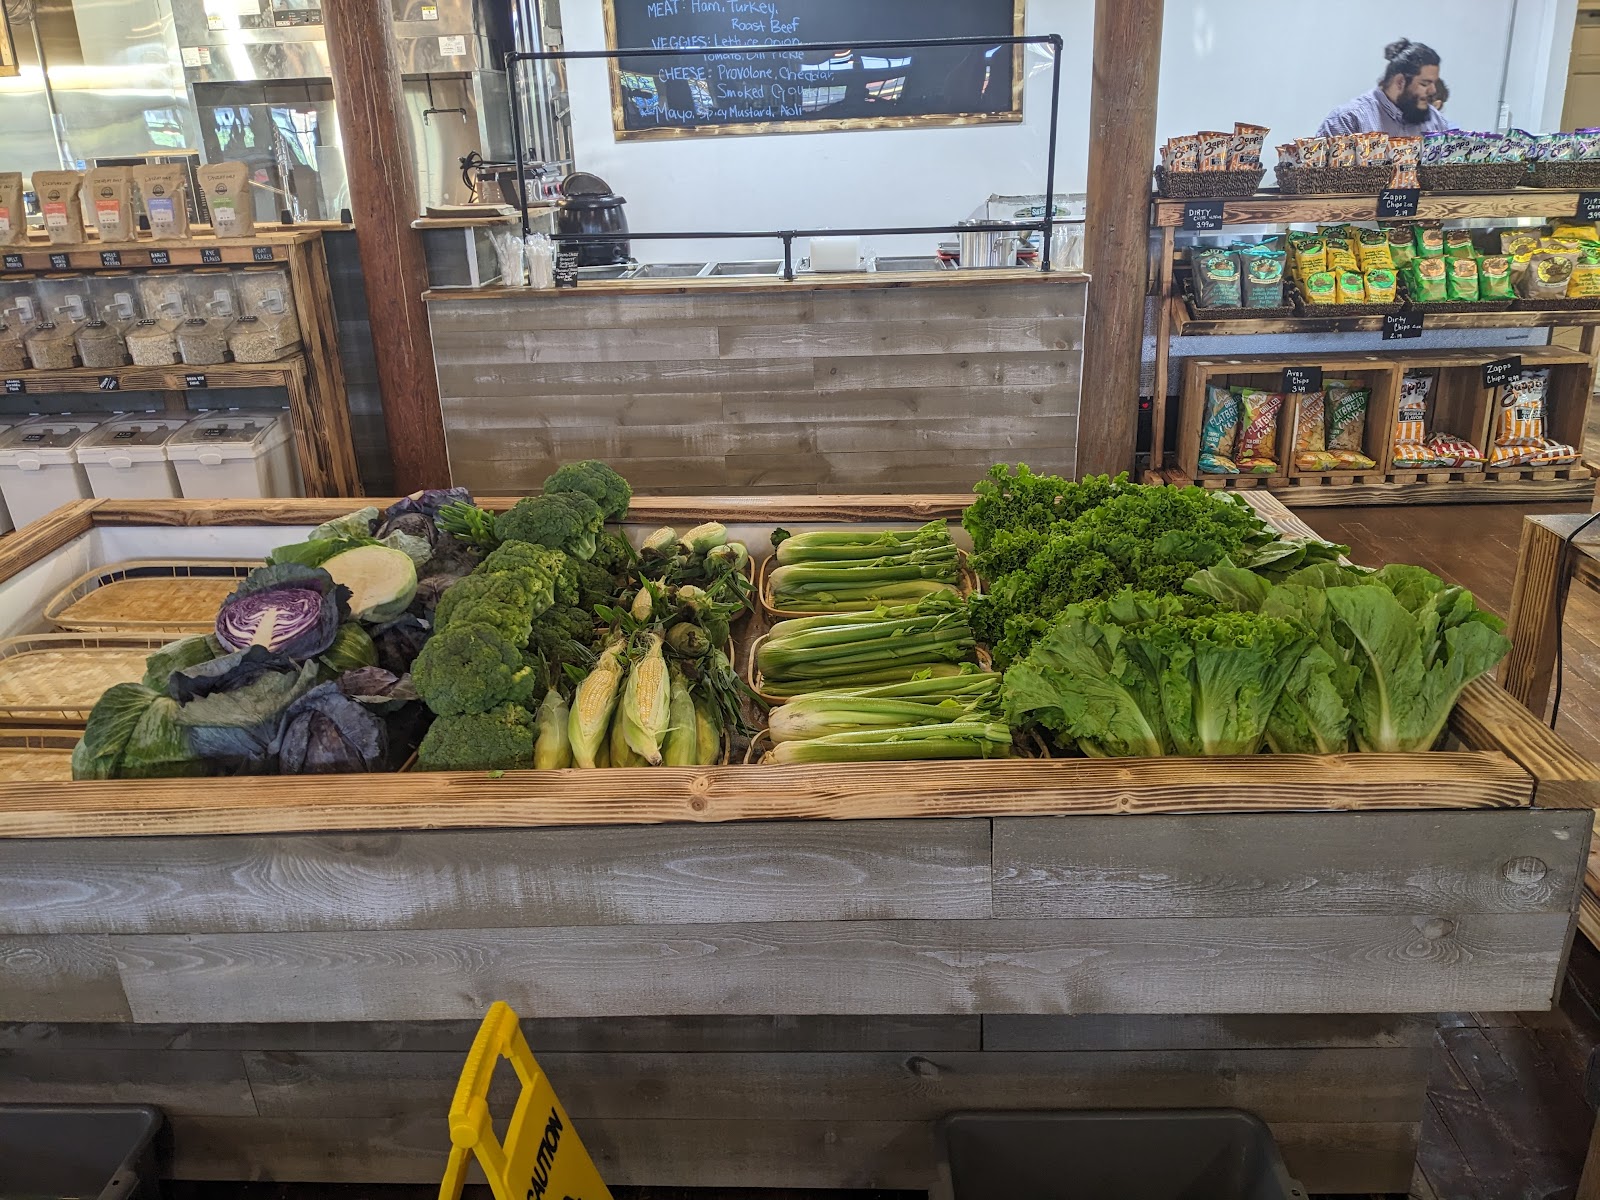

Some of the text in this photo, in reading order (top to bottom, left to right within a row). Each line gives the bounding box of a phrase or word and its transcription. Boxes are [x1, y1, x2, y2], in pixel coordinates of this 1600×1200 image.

[731, 16, 800, 34] Roast Beef
[717, 83, 764, 99] Smoked
[1387, 316, 1406, 324] Dirty
[1487, 363, 1511, 373] Zapps
[1486, 374, 1505, 384] Chips
